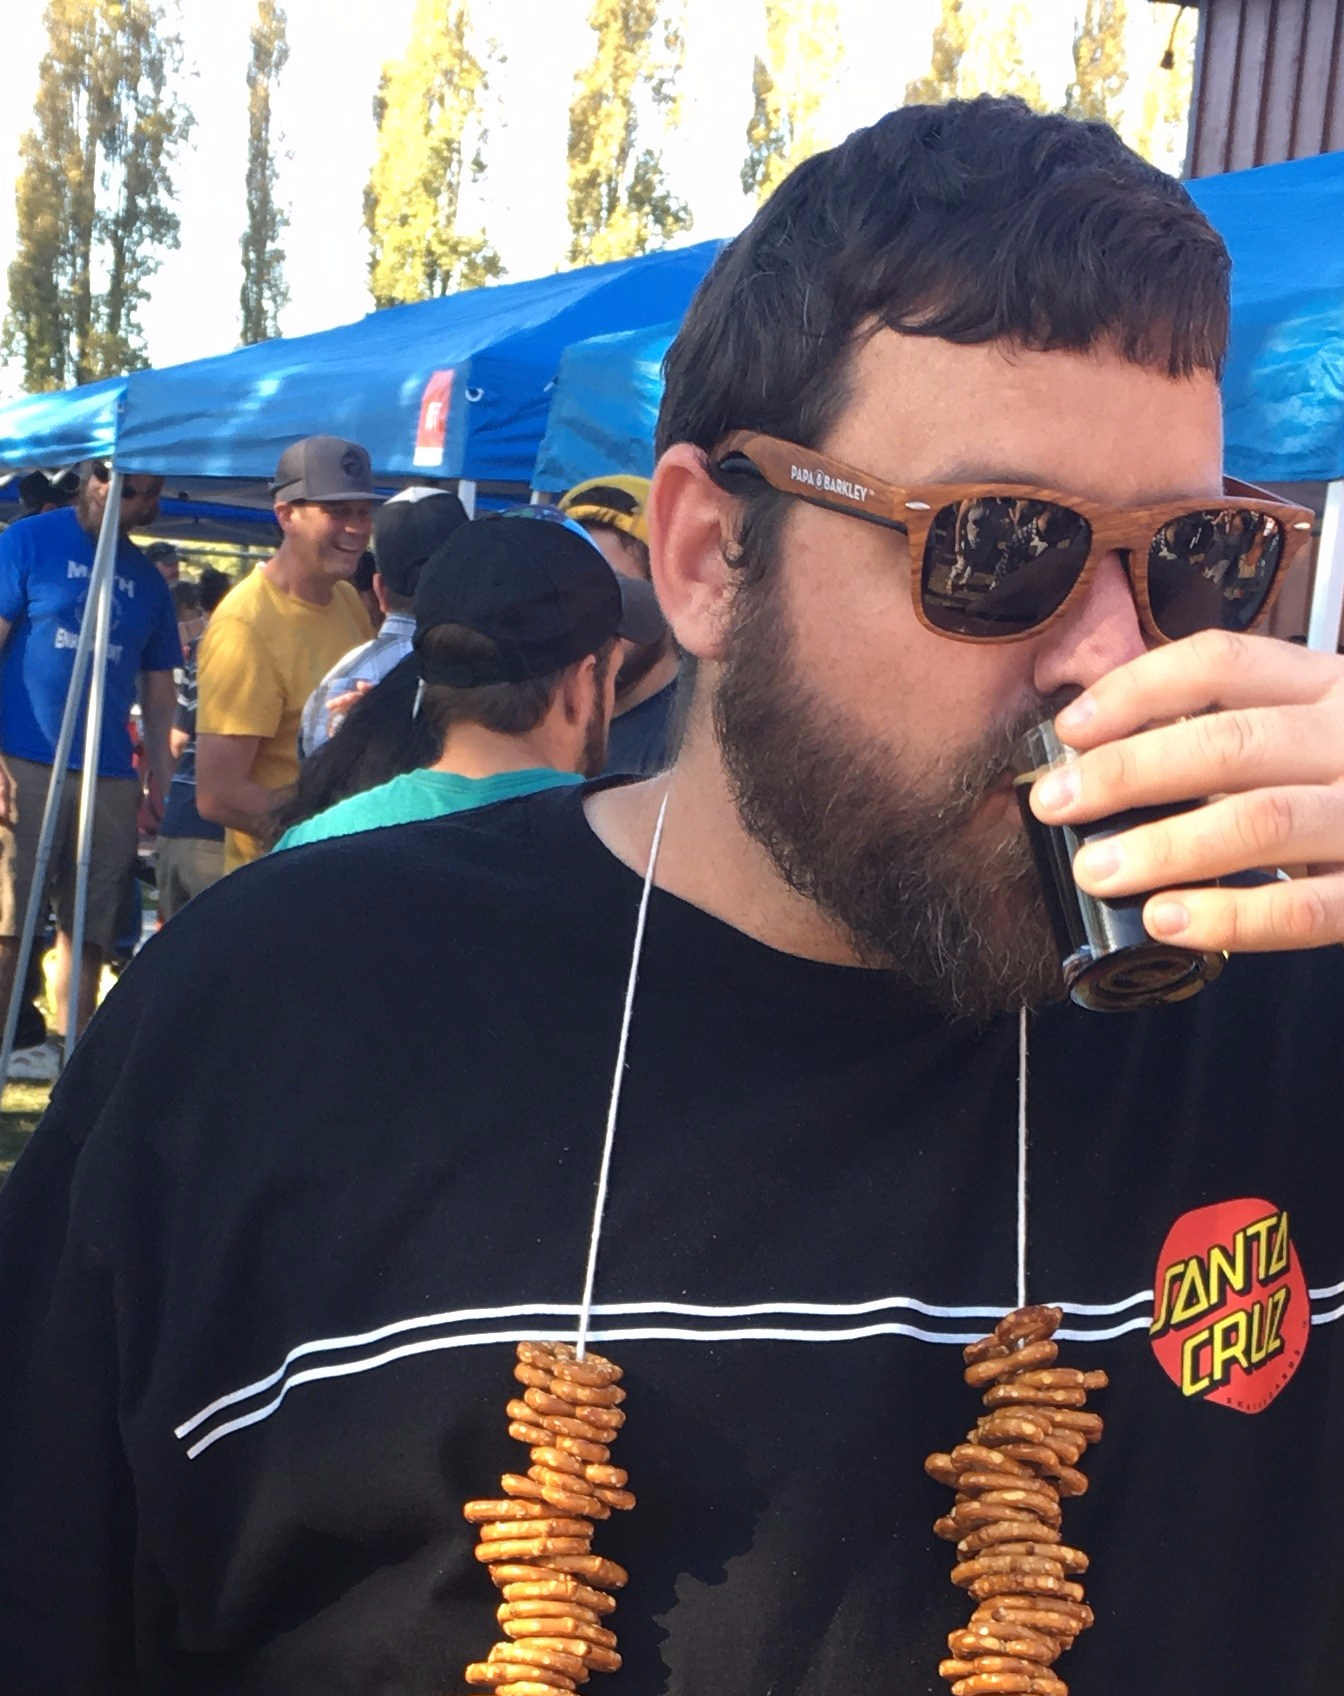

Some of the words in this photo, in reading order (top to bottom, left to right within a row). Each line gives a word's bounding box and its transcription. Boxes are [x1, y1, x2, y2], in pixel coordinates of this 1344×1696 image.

[791, 465, 814, 485] PAPA
[824, 475, 868, 502] BARKLEY
[1149, 1210, 1291, 1336] SANTA
[1180, 1287, 1289, 1398] CRUZ
